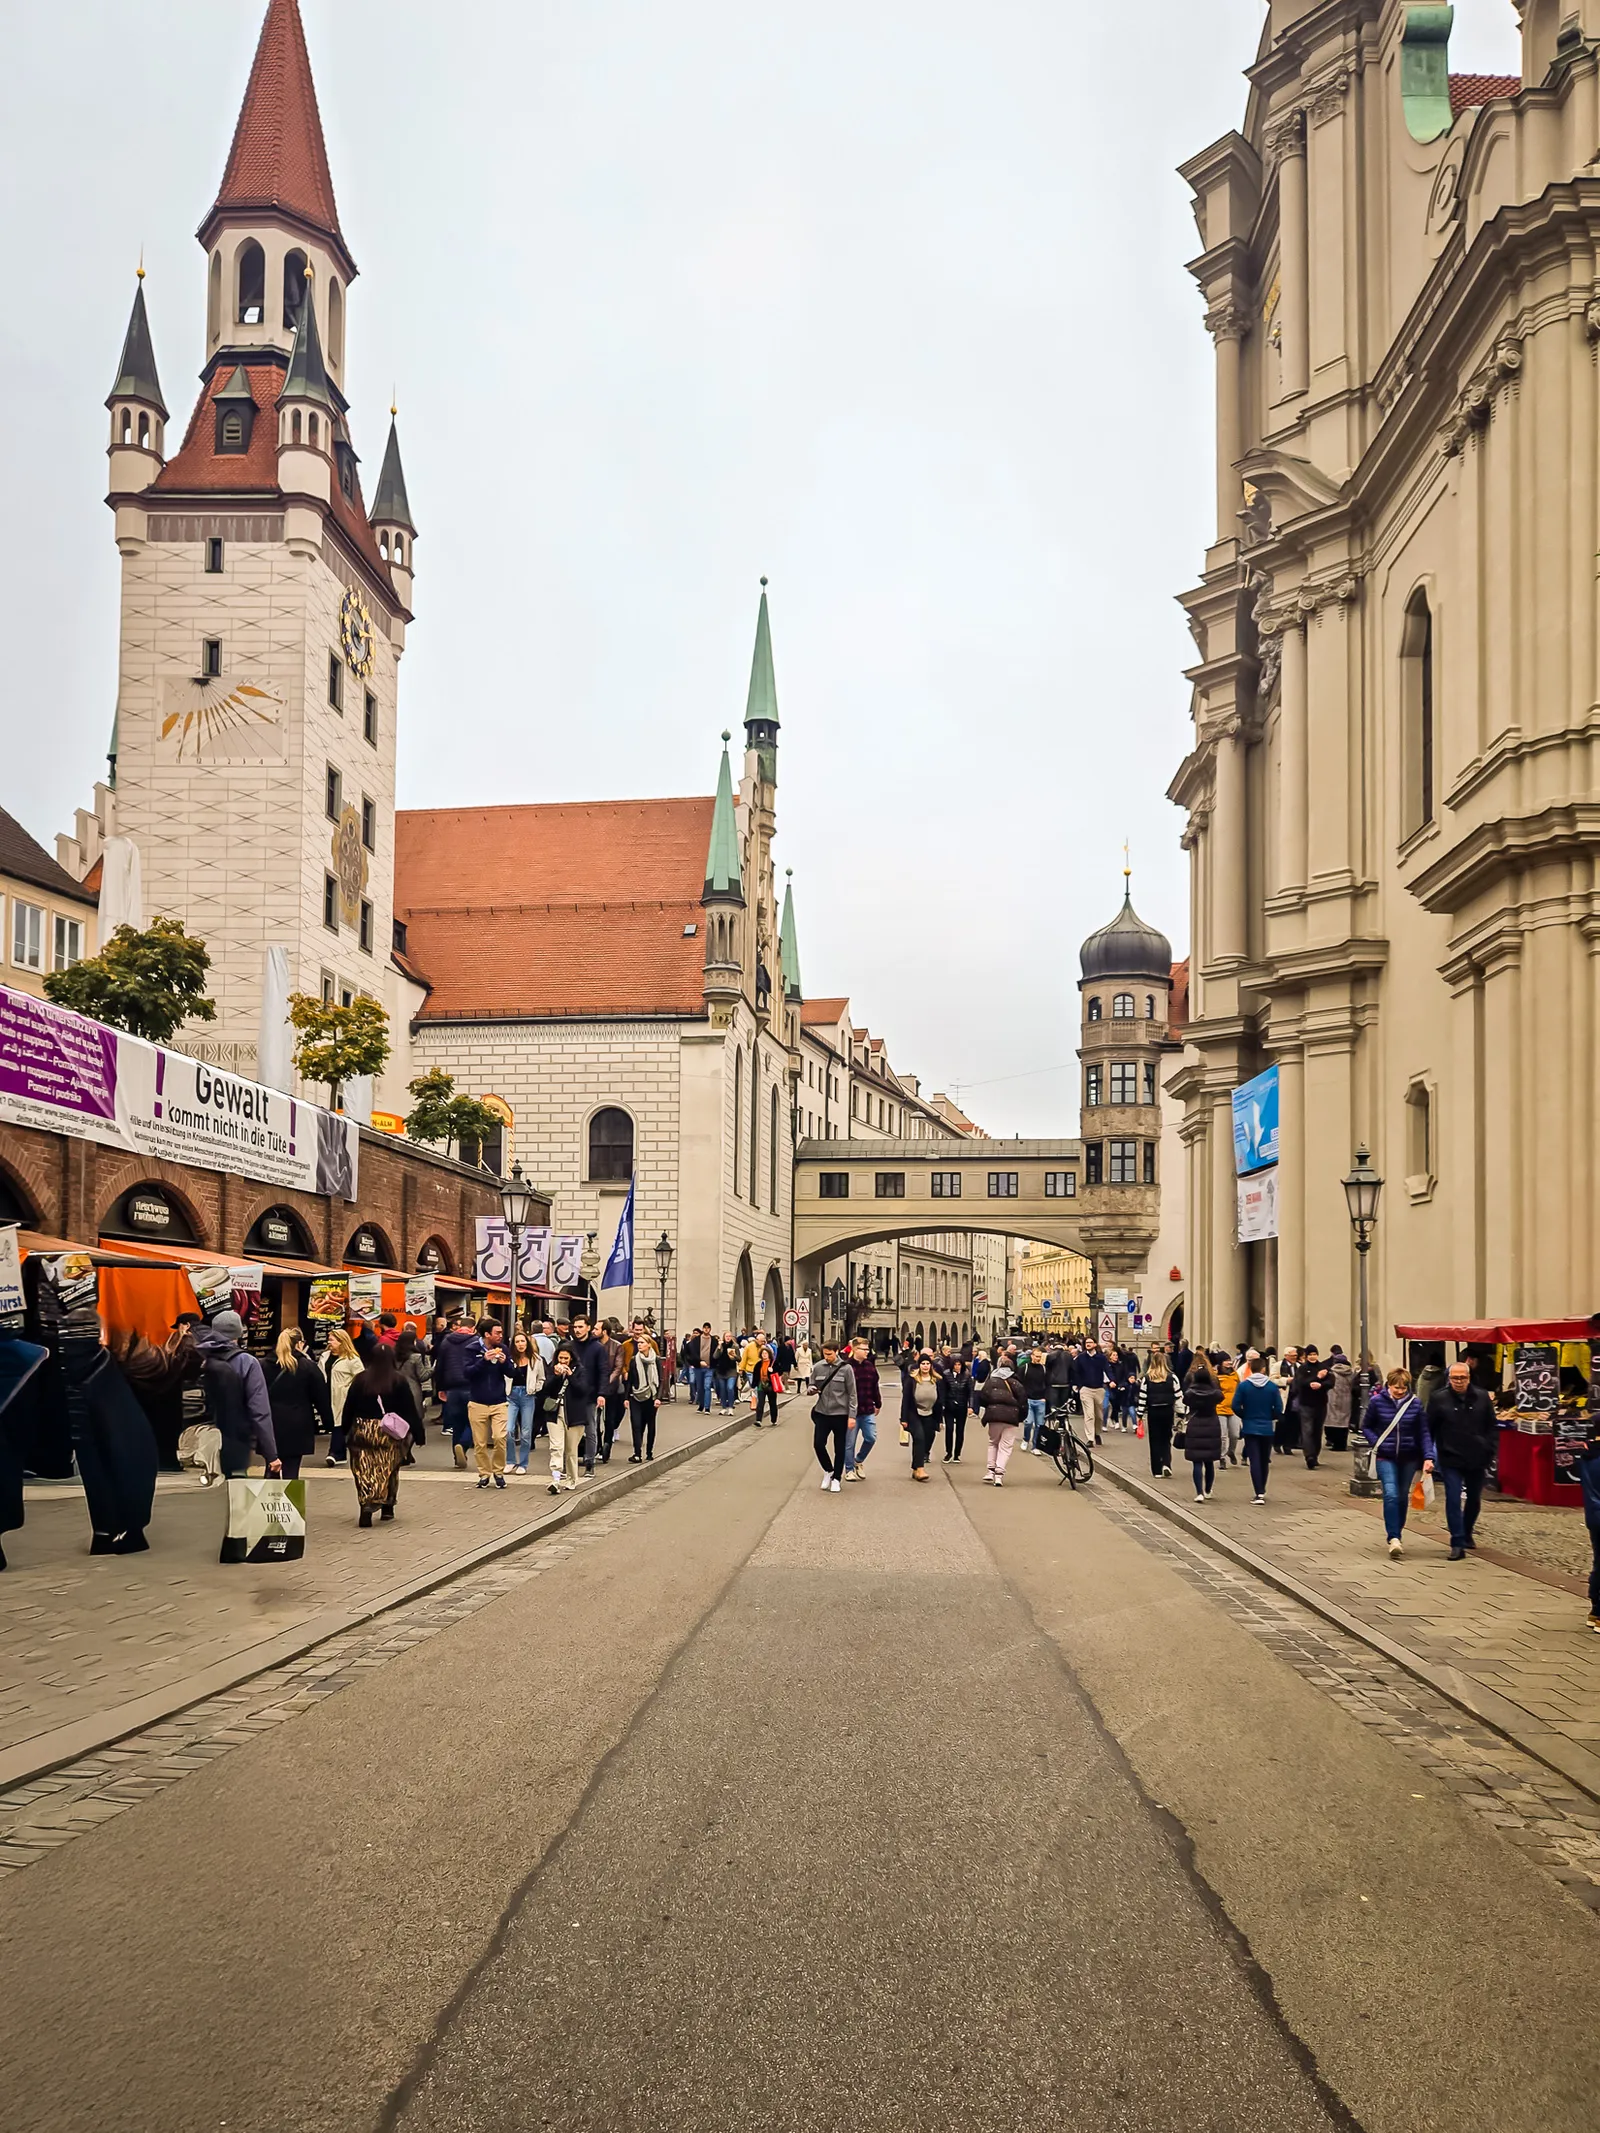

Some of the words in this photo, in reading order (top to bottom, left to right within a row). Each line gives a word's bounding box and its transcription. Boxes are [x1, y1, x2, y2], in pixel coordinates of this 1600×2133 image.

[196, 1062, 269, 1125] Gewalt
[167, 1099, 210, 1132] kommt
[213, 1113, 239, 1140] nicht
[240, 1122, 249, 1143] in
[250, 1126, 265, 1147] die
[267, 1131, 287, 1154] Tüte
[261, 1502, 293, 1512] VOLLER
[266, 1513, 291, 1523] IDEEN
